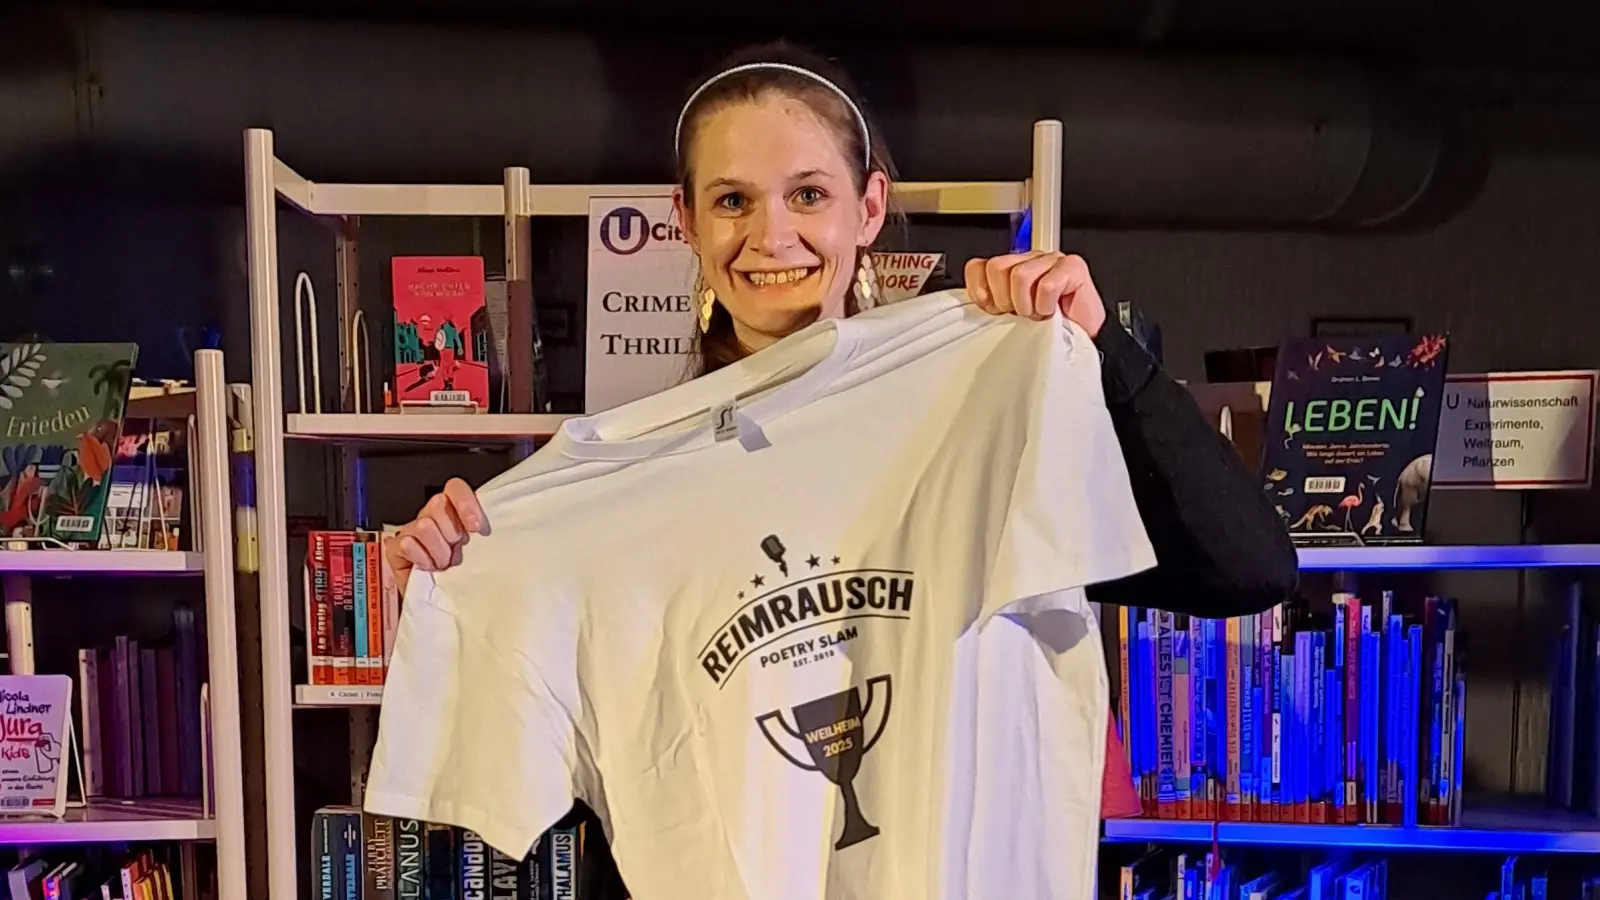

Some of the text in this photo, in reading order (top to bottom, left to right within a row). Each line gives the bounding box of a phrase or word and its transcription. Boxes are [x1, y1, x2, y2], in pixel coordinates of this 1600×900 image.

[651, 222, 689, 244] Cit
[602, 291, 691, 312] CRIME
[1284, 397, 1420, 432] LEBEN!
[1446, 393, 1578, 409] U Naturwissenschaft
[6, 406, 90, 437] Frieden
[1464, 419, 1544, 432] Experimente,
[1462, 456, 1515, 467] Pflanzen
[702, 576, 914, 683] REIMRAUSCH
[760, 626, 858, 668] POETRY SLAM
[1159, 626, 1172, 672] ALLES
[0, 689, 30, 702] icola
[1159, 675, 1172, 701] IST
[6, 700, 52, 715] Lindner
[805, 715, 861, 744] WEILHEIM
[822, 737, 853, 758] 2025
[367, 836, 377, 873] TERRY
[375, 818, 387, 890] PRATCHETT
[400, 820, 420, 900] LANUS
